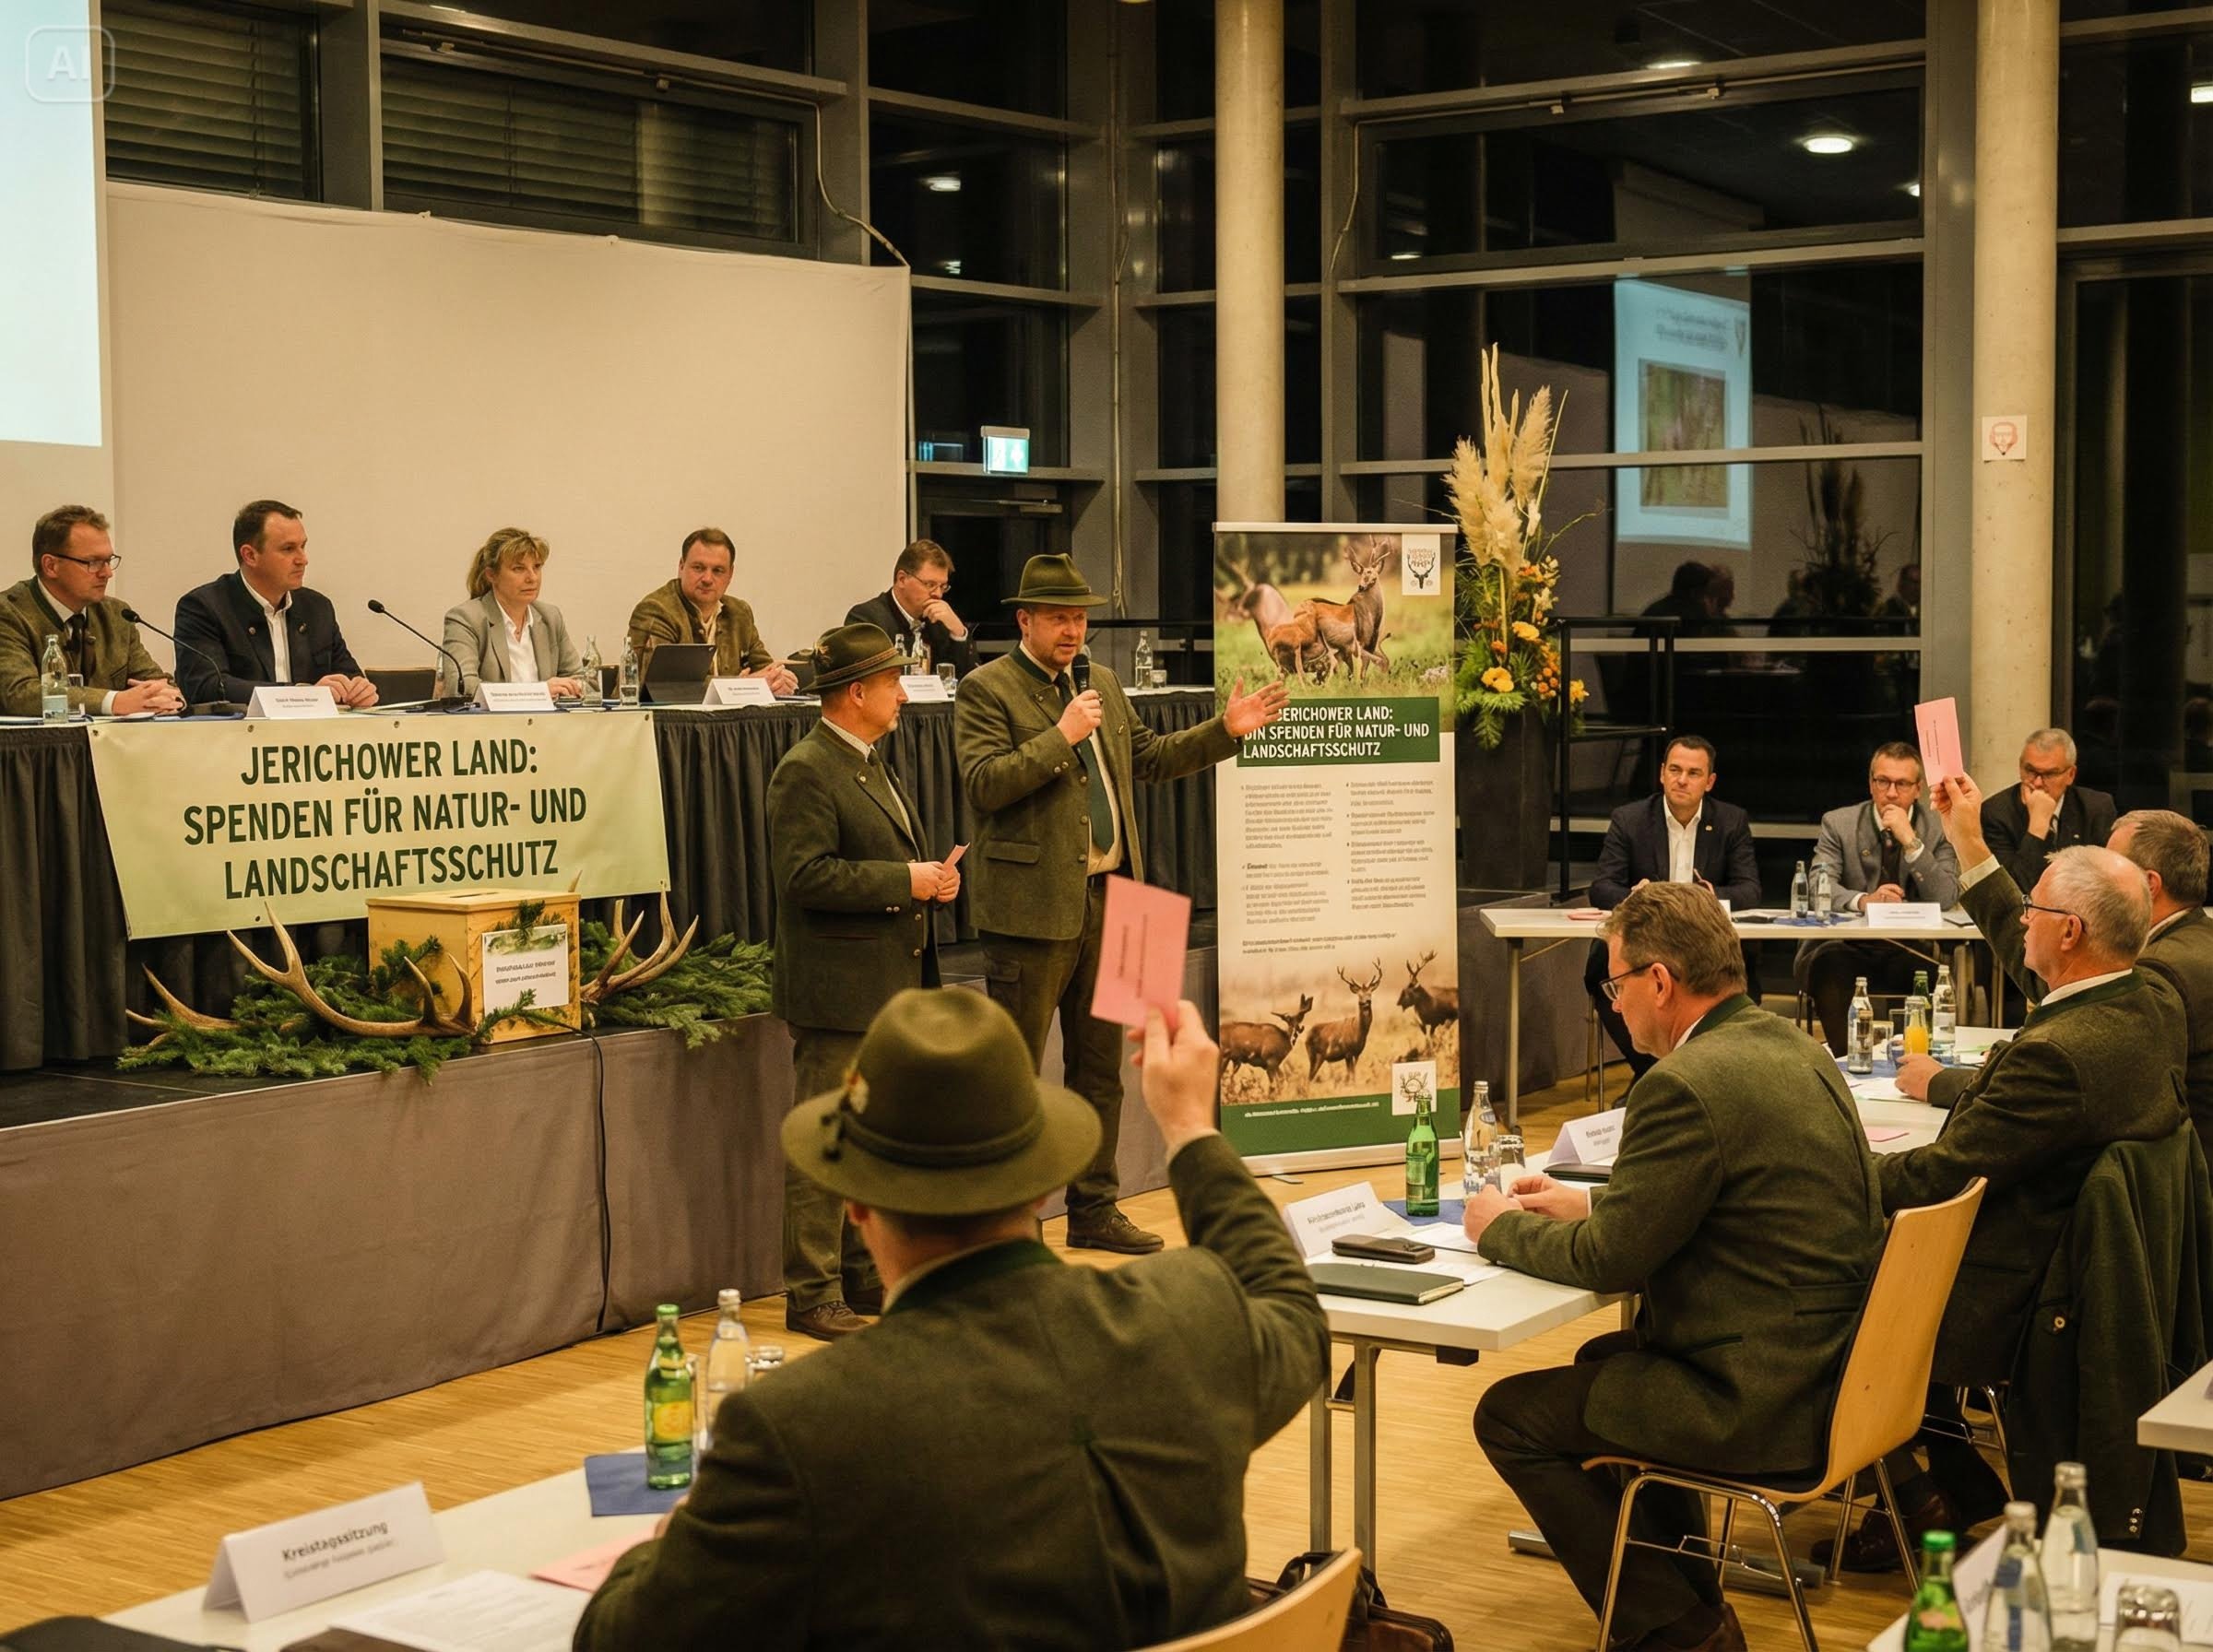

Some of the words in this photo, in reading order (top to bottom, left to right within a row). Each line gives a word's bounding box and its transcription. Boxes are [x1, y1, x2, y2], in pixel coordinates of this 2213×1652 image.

[1355, 724, 1402, 738] NATUR-
[1403, 723, 1430, 738] UND
[1356, 706, 1393, 721] LAND:
[240, 740, 442, 785] JERICHOWER
[453, 738, 538, 777] LAND:
[1243, 741, 1381, 759] LANDSCHAFTSSCHUTZ
[183, 799, 333, 845] SPENDEN
[345, 787, 403, 835] FÜR
[413, 791, 521, 831] NATUR-
[530, 787, 587, 823] UND
[224, 839, 559, 900] LANDSCHAFTSSCHUTZ
[281, 1521, 389, 1561] Kreistagssitzung
